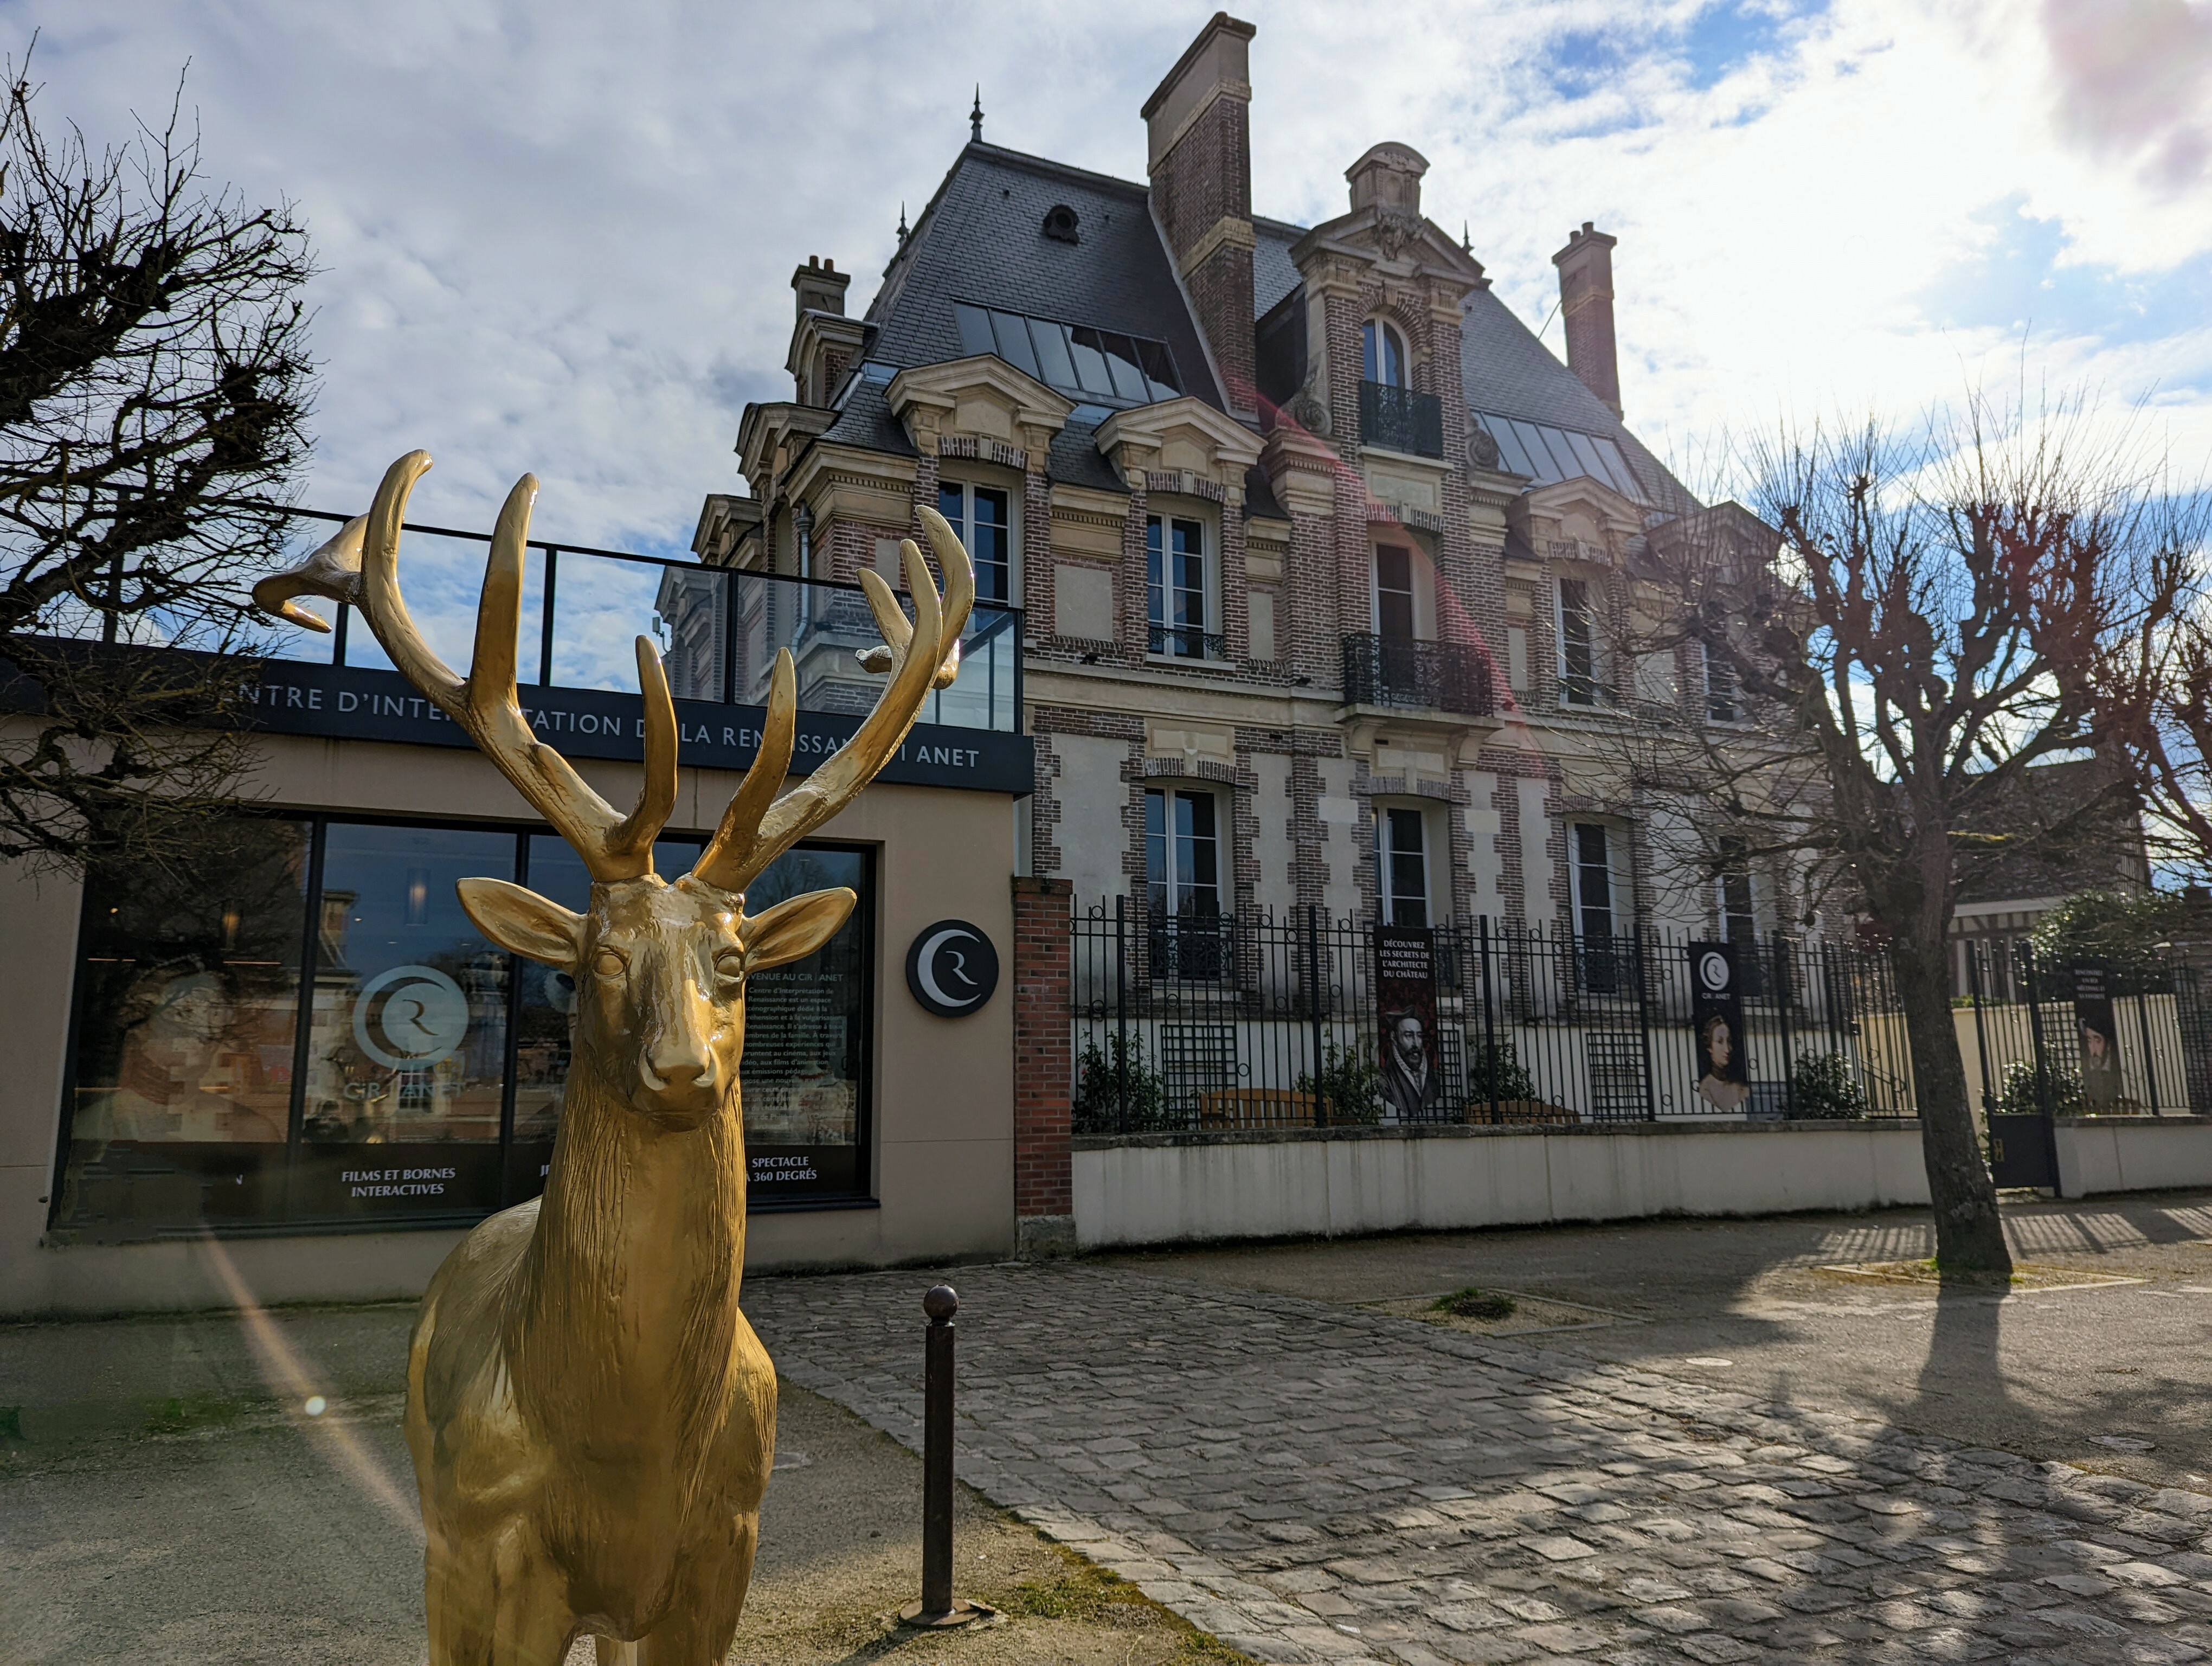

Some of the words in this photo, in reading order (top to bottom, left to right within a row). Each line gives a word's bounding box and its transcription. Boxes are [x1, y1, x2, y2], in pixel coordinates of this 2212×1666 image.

[681, 723, 711, 744] LA
[723, 727, 847, 754] RENISSA
[917, 746, 980, 767] ANET
[1384, 938, 1425, 949] DÉCOUVREZ
[1392, 950, 1419, 958] SECRETS
[1382, 960, 1428, 969] L'ARCHITECTE
[1383, 970, 1395, 978] DU
[1396, 969, 1429, 979] CHÂTEAU
[752, 1156, 809, 1168] SPECTACLE
[342, 1171, 381, 1182] FILMS
[384, 1169, 398, 1180] ET
[402, 1168, 456, 1181] BORNES
[754, 1171, 774, 1182] 360
[776, 1168, 817, 1181] DEGRÉS
[351, 1183, 445, 1197] INTERACTIVES
